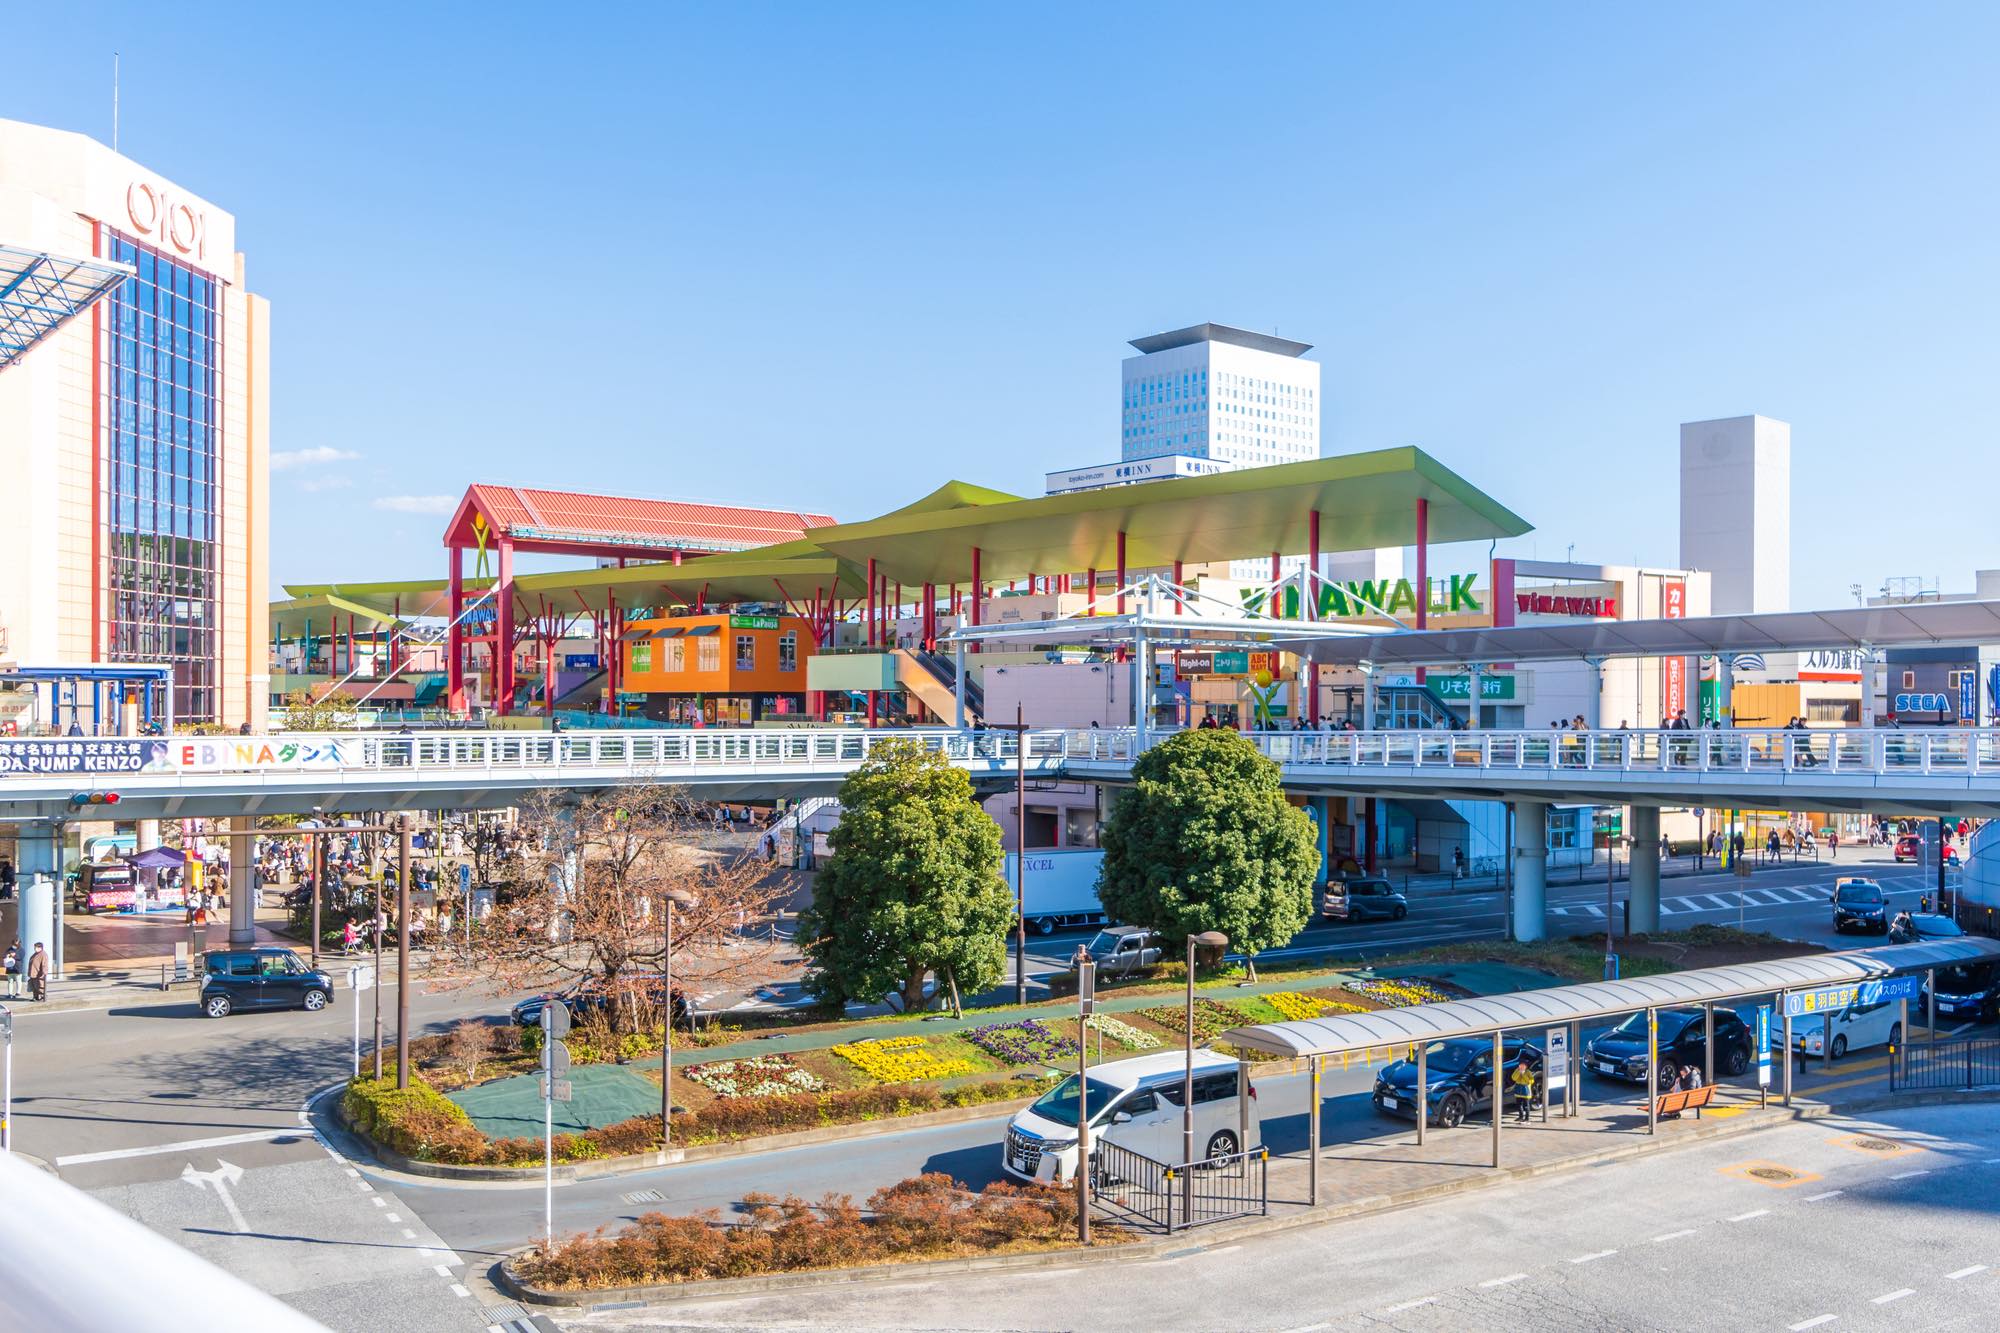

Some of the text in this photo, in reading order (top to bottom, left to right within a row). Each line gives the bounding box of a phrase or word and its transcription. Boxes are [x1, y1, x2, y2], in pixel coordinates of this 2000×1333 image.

[1251, 654, 1267, 664] ABC
[1896, 693, 1951, 712] SEGA
[29, 757, 80, 771] PUMP
[85, 756, 142, 770] KENZO
[1024, 860, 1055, 871] XCEL
